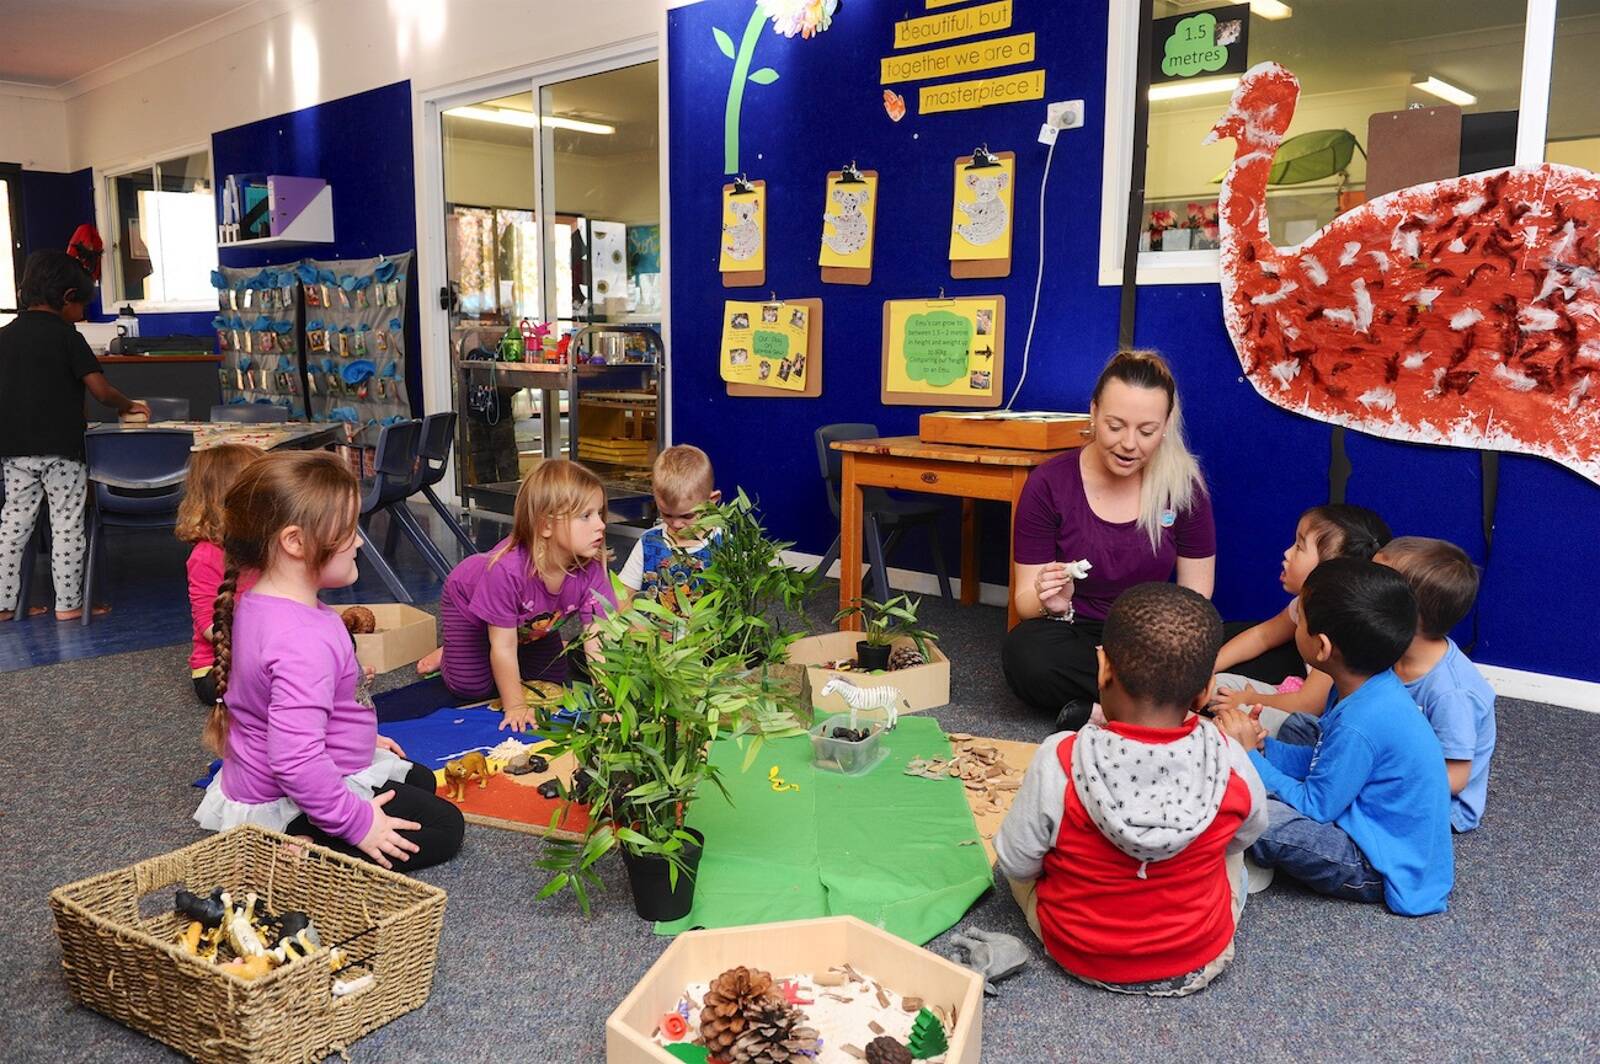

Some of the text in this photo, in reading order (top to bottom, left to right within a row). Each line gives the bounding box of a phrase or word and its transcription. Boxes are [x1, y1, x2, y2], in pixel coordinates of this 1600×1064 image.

[901, 5, 1008, 41] beautiful, but
[1185, 24, 1207, 41] 1.5
[887, 42, 1031, 79] together we are a
[1169, 49, 1220, 67] metres
[925, 79, 1029, 107] masterpiece
